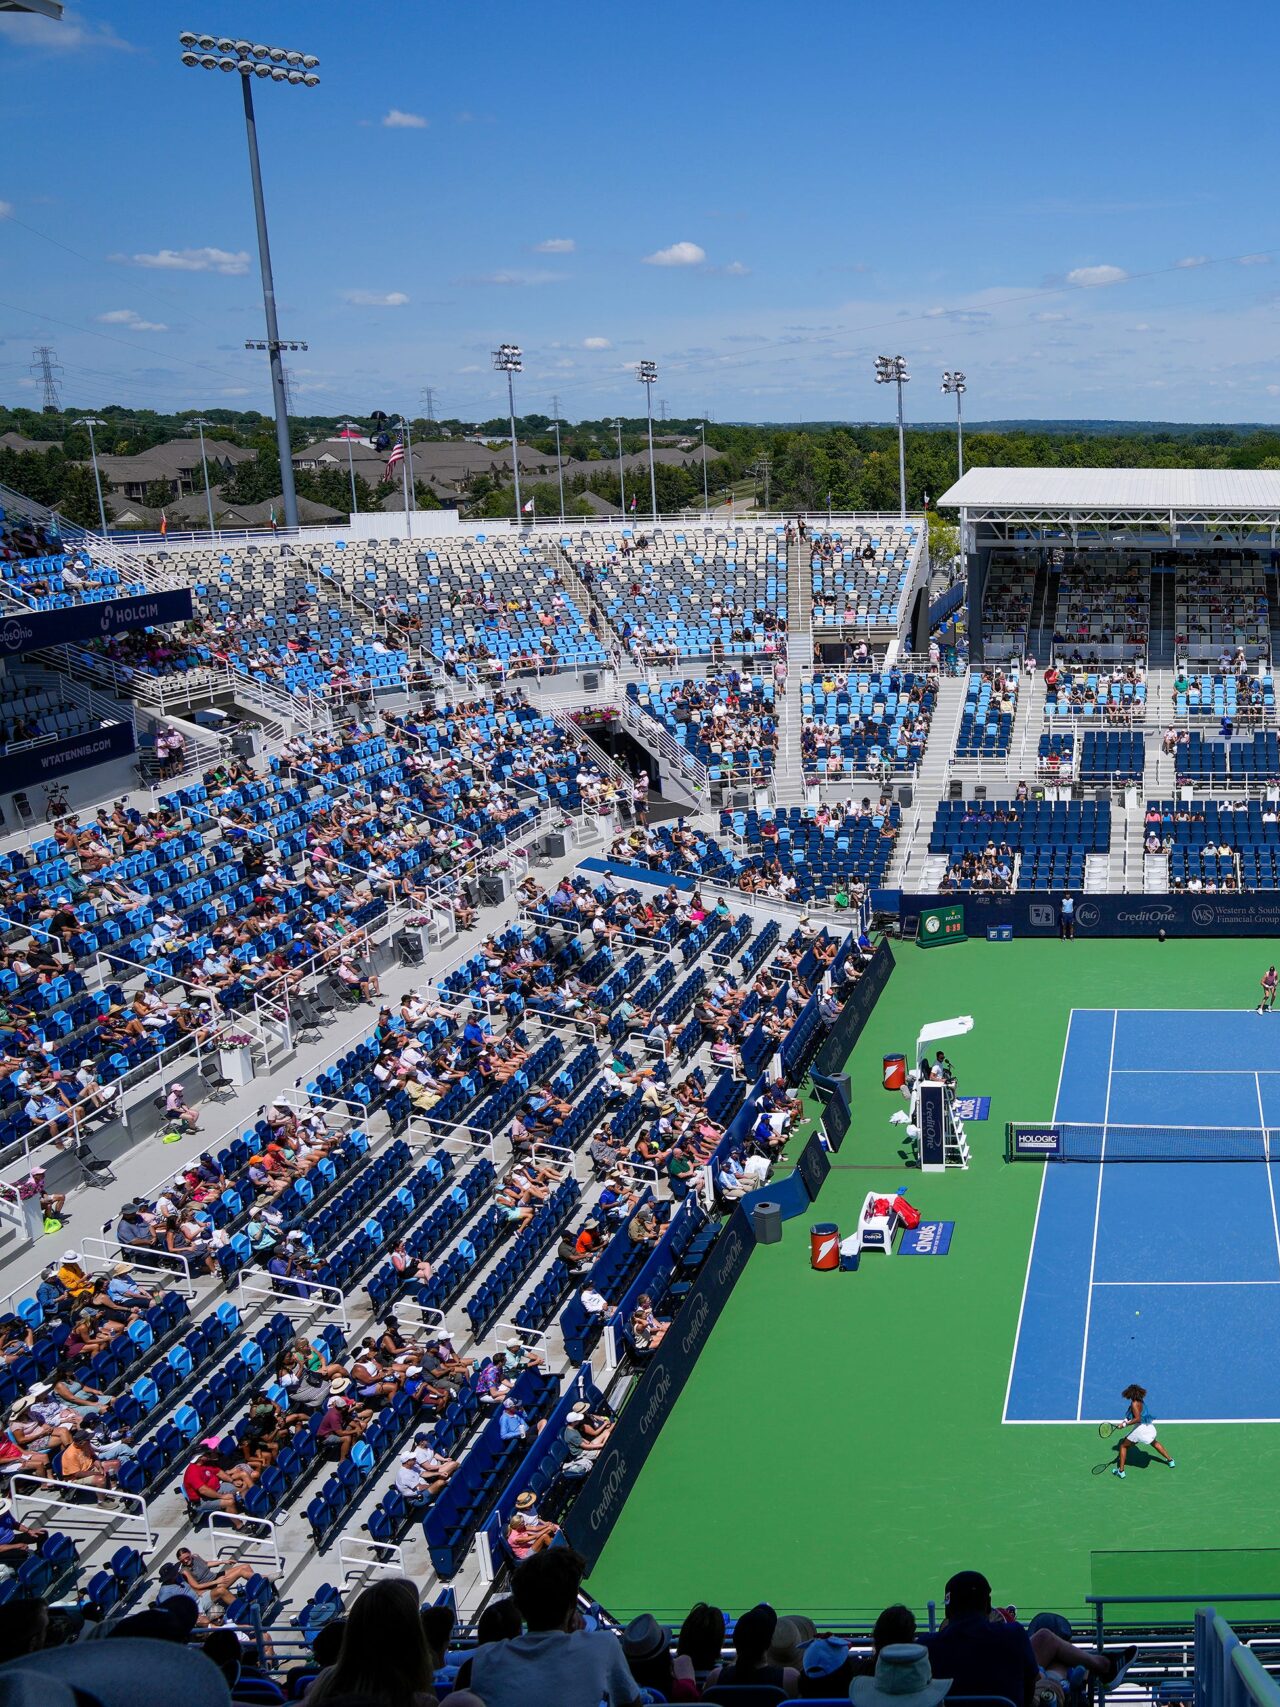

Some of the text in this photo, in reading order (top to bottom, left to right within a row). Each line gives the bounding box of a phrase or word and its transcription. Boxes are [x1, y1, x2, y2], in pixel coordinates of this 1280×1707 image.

[116, 603, 159, 623] HOLCIM
[0, 627, 33, 642] obsOhio
[40, 738, 112, 768] WTATENNIS.COM
[1080, 910, 1098, 919] P&G
[1117, 910, 1176, 921] CreditOne
[1215, 906, 1247, 914] Western
[1248, 906, 1255, 914] &
[1217, 915, 1280, 925] Financial Group
[926, 1100, 936, 1150] CreditOne
[1018, 1135, 1057, 1143] HOLOGIC
[717, 1240, 743, 1286] CreditOne
[682, 1302, 710, 1354] CreditOne
[639, 1372, 672, 1436] CreditOne
[590, 1455, 627, 1531] CreditOne
